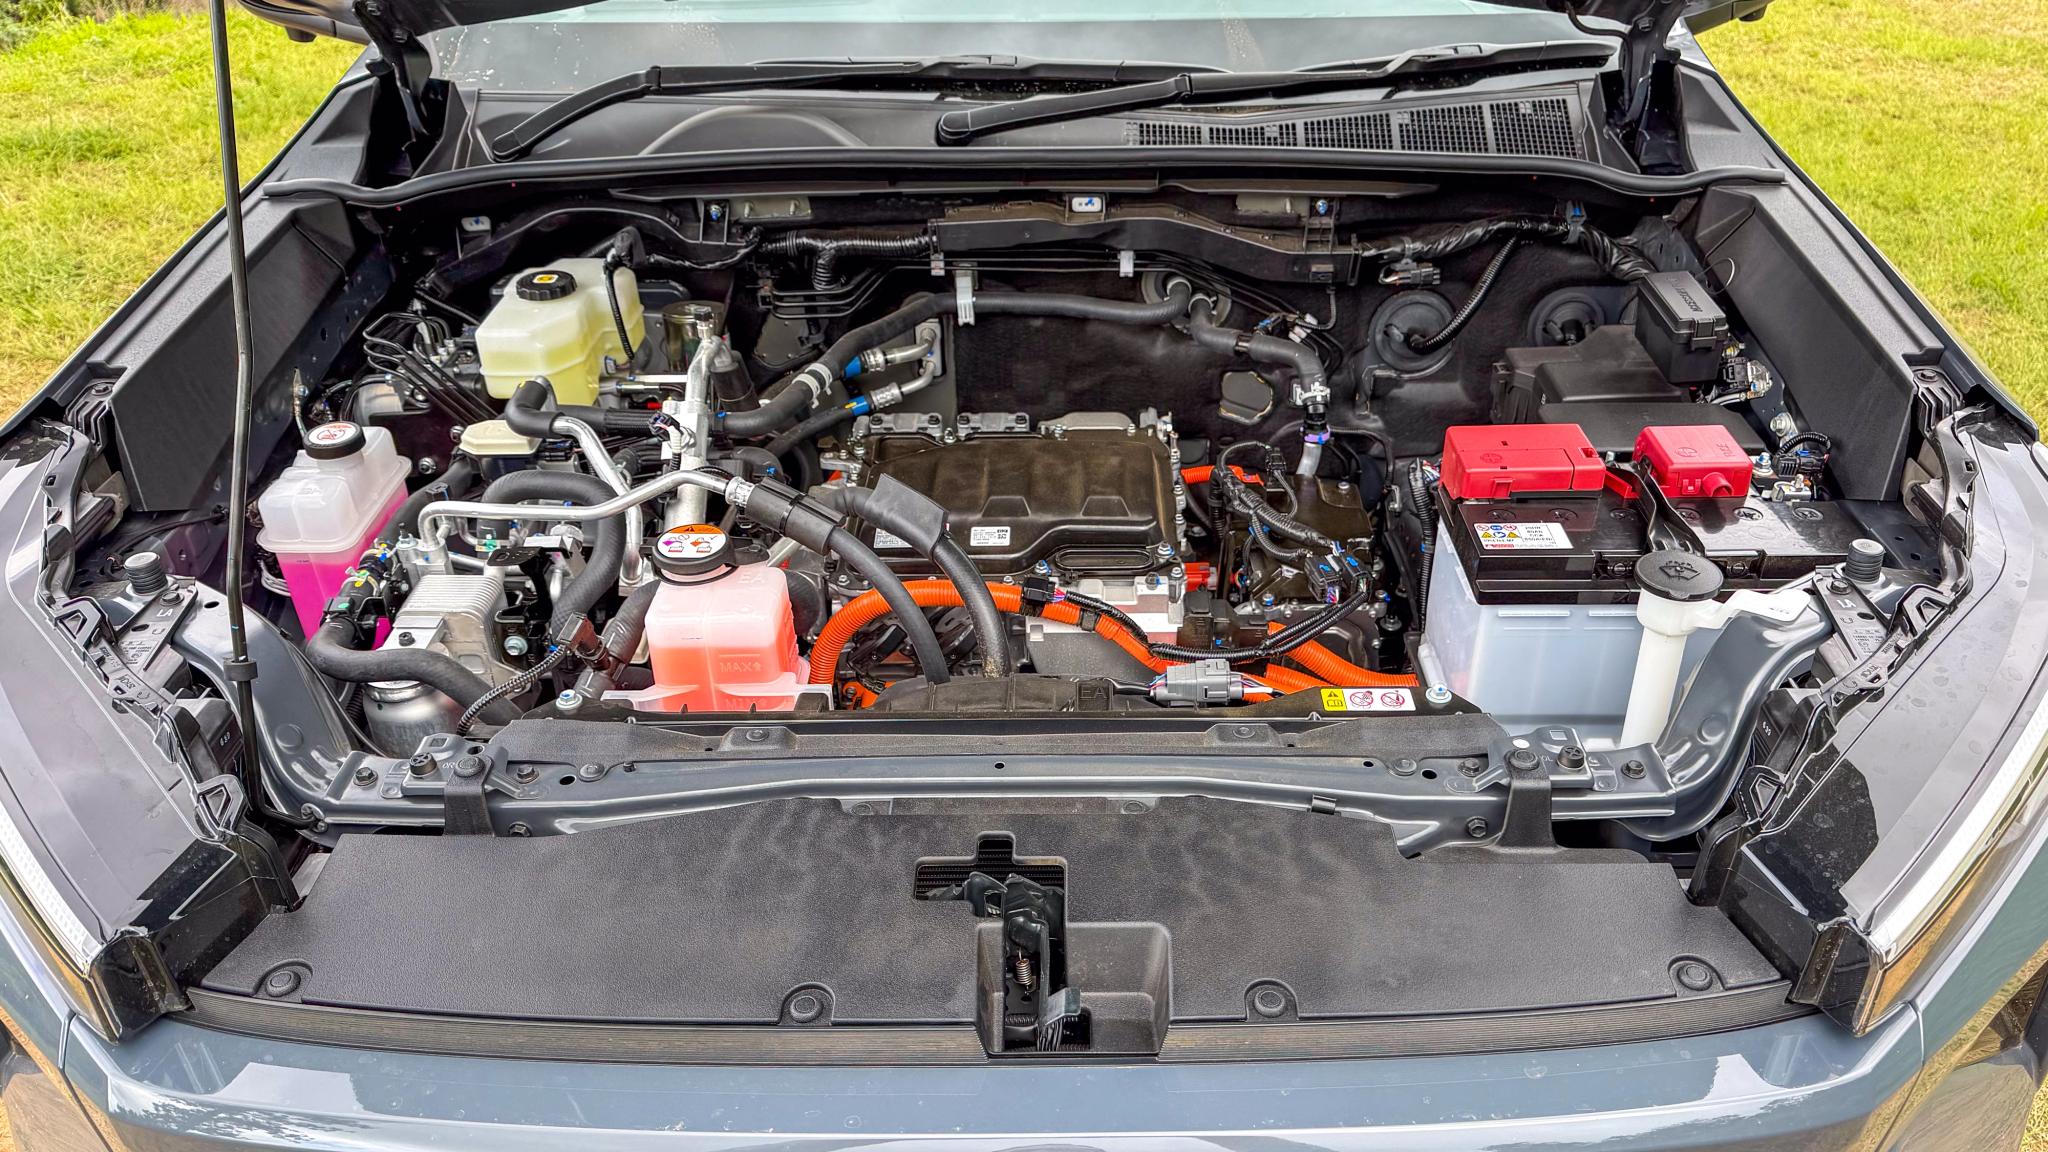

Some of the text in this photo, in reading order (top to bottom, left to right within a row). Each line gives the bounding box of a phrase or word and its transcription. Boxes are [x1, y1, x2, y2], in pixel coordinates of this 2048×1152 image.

[156, 608, 173, 617] LA
[720, 662, 752, 673] MAX
[1080, 685, 1107, 700] EA
